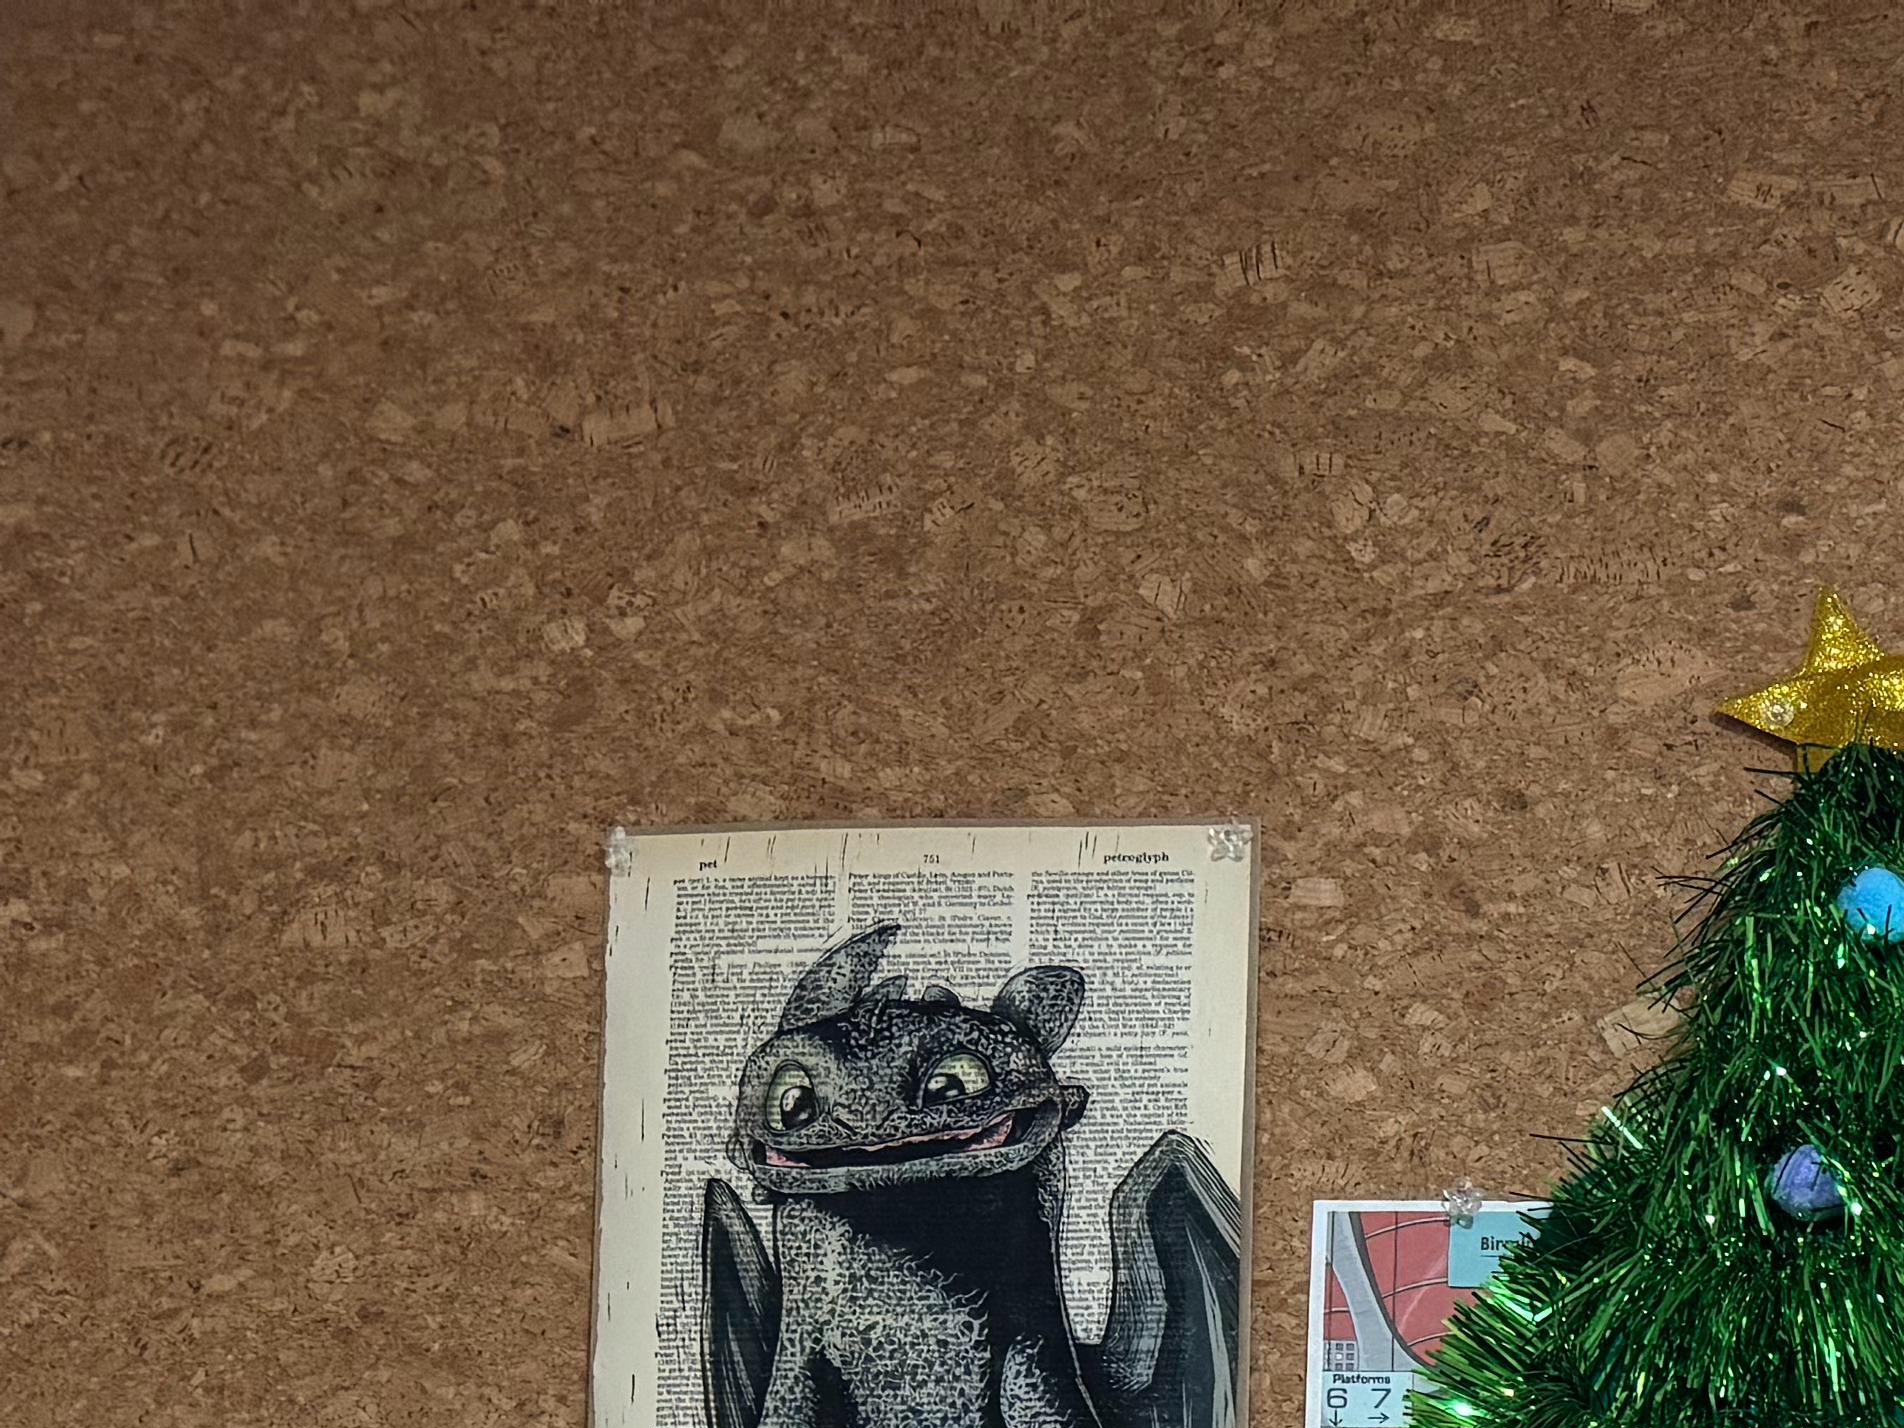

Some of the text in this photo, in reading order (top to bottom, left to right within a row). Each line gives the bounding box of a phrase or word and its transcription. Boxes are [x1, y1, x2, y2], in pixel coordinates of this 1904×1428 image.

[923, 854, 940, 864] 751
[1103, 851, 1169, 864] petroglyph
[699, 859, 718, 871] pet
[1332, 1373, 1391, 1385] Platforms
[1326, 1387, 1393, 1409] 6 7
